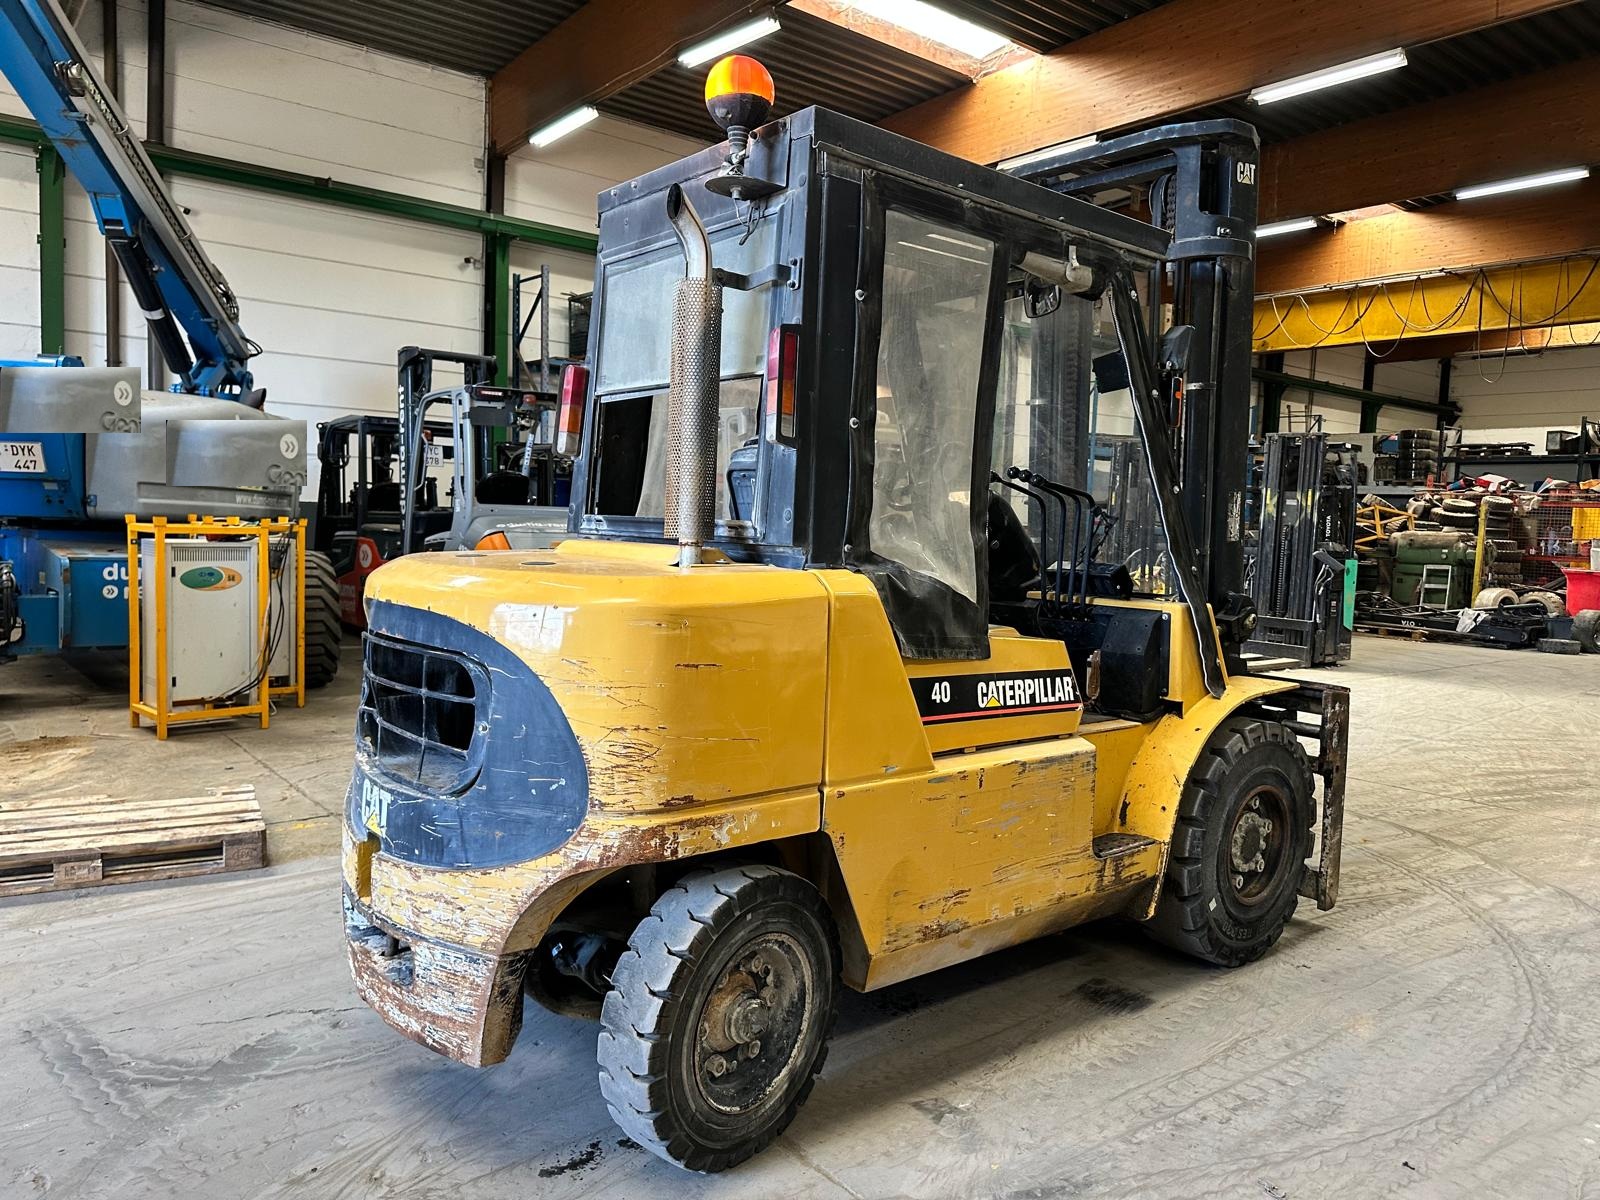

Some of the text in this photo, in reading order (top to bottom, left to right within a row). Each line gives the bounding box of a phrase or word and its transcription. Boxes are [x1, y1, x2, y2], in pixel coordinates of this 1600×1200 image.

[1236, 162, 1256, 185] CAT
[10, 444, 36, 456] DYK
[14, 459, 37, 470] 447
[931, 676, 1074, 708] 40 CATERPILLAR
[361, 778, 391, 838] CAT
